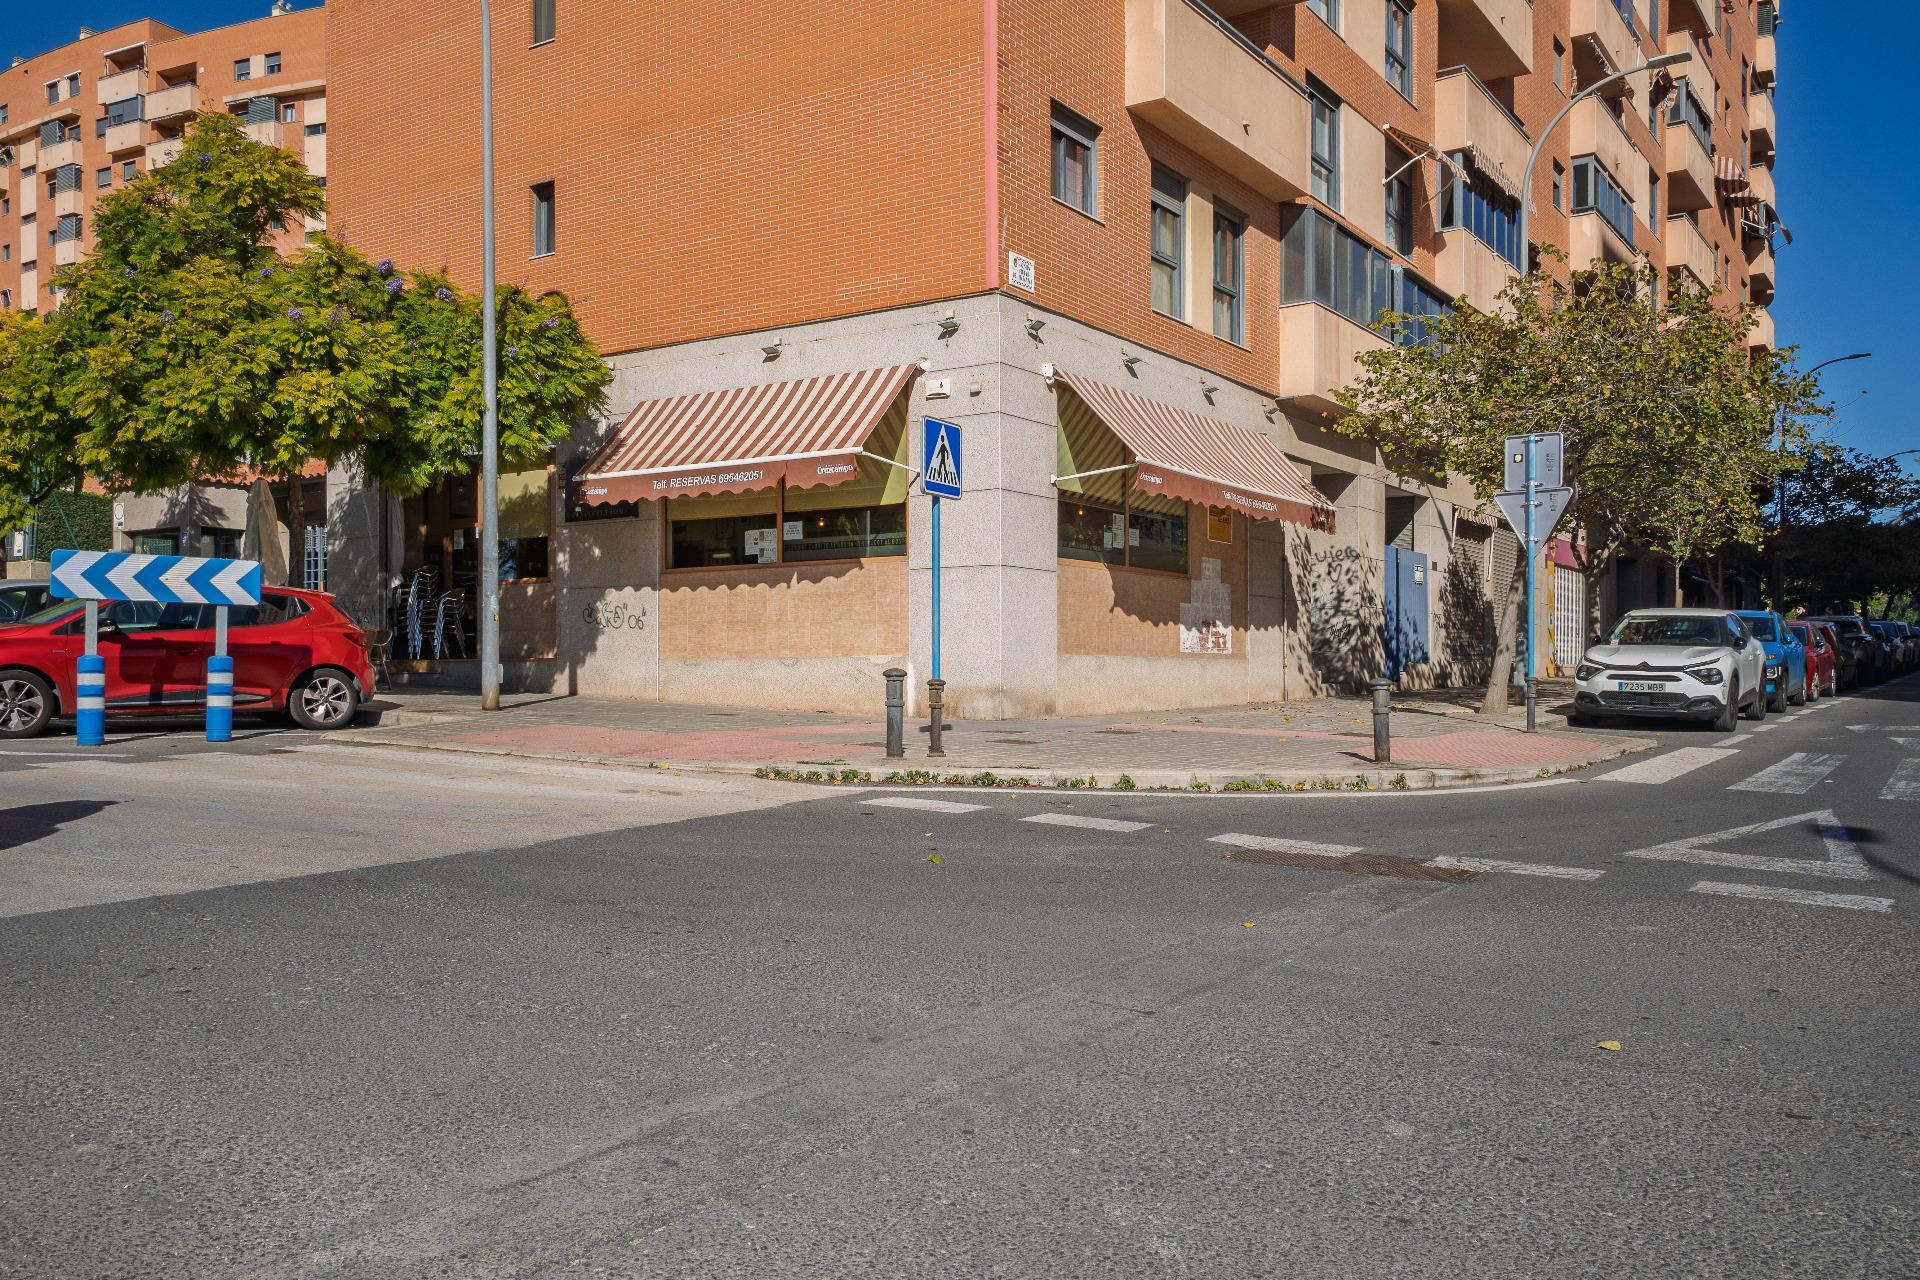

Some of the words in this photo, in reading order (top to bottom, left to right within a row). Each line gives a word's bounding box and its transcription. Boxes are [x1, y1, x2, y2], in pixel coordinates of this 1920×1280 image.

[817, 464, 853, 475] Cruzcampo
[653, 480, 668, 490] Telf.
[670, 475, 716, 488] RESERVAS
[718, 470, 764, 483] 695462051
[1624, 682, 1645, 691] 7235
